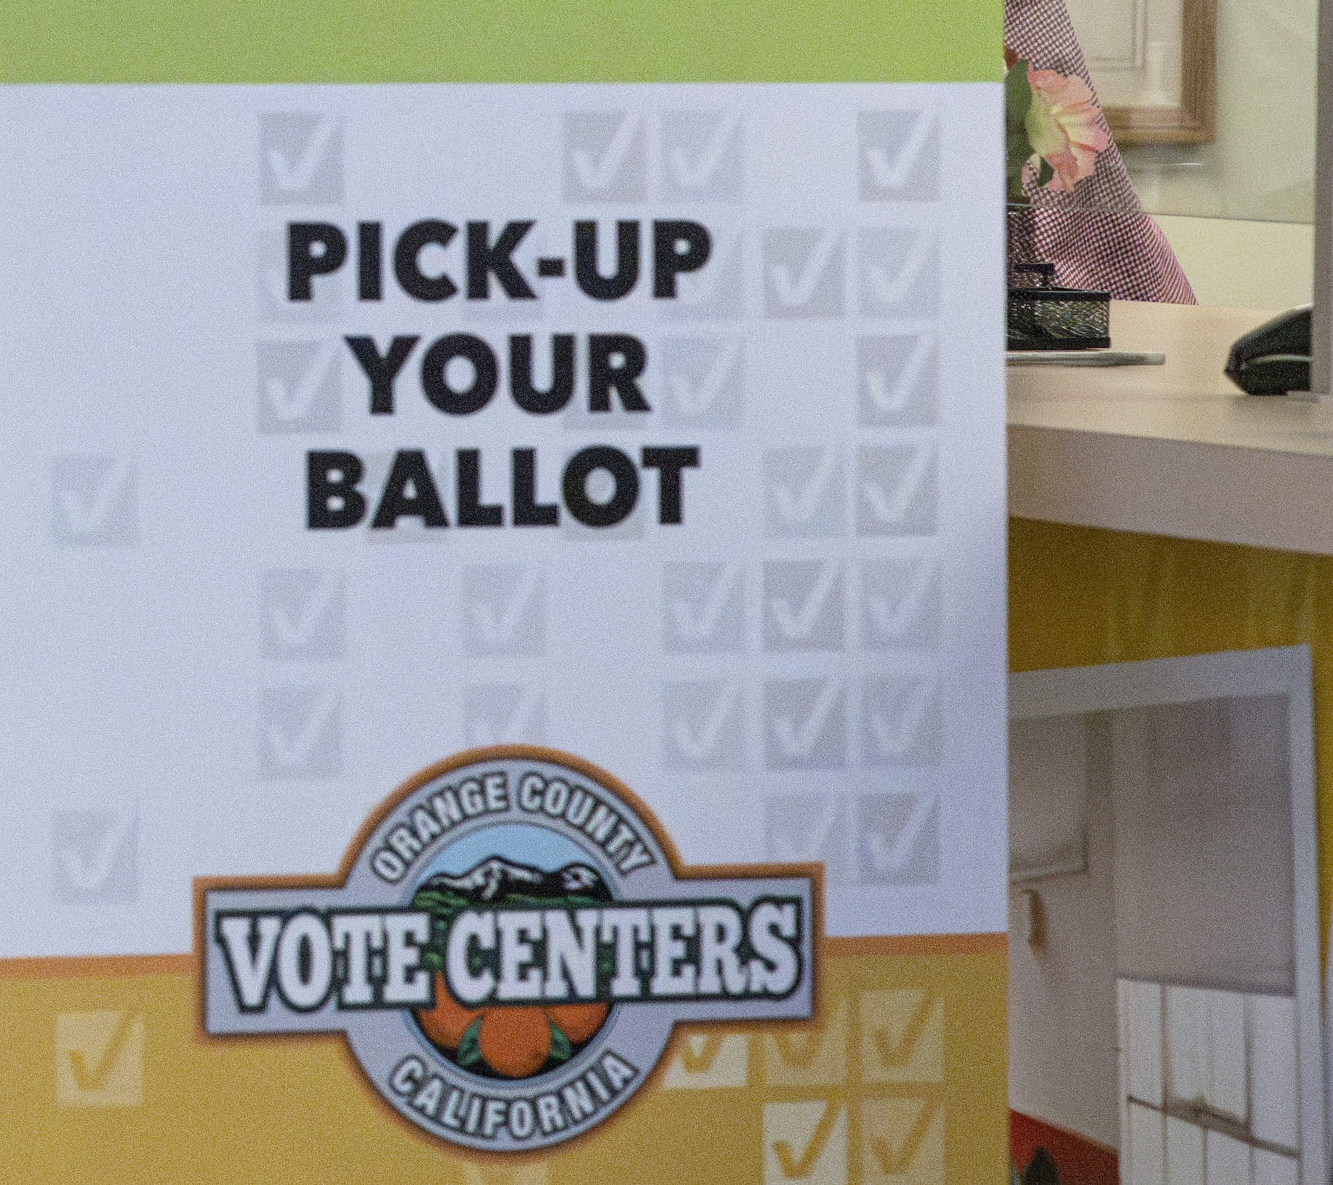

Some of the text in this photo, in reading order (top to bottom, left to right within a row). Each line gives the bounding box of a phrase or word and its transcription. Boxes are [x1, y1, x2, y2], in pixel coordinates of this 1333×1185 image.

[286, 220, 712, 302] PICK-UP
[344, 332, 652, 417] YOUR
[306, 445, 700, 531] BALLOT
[370, 770, 659, 884] ORANGE COUNTY
[217, 897, 804, 1014] VOTE CENTERS
[388, 1047, 641, 1143] CALIFORNIA
